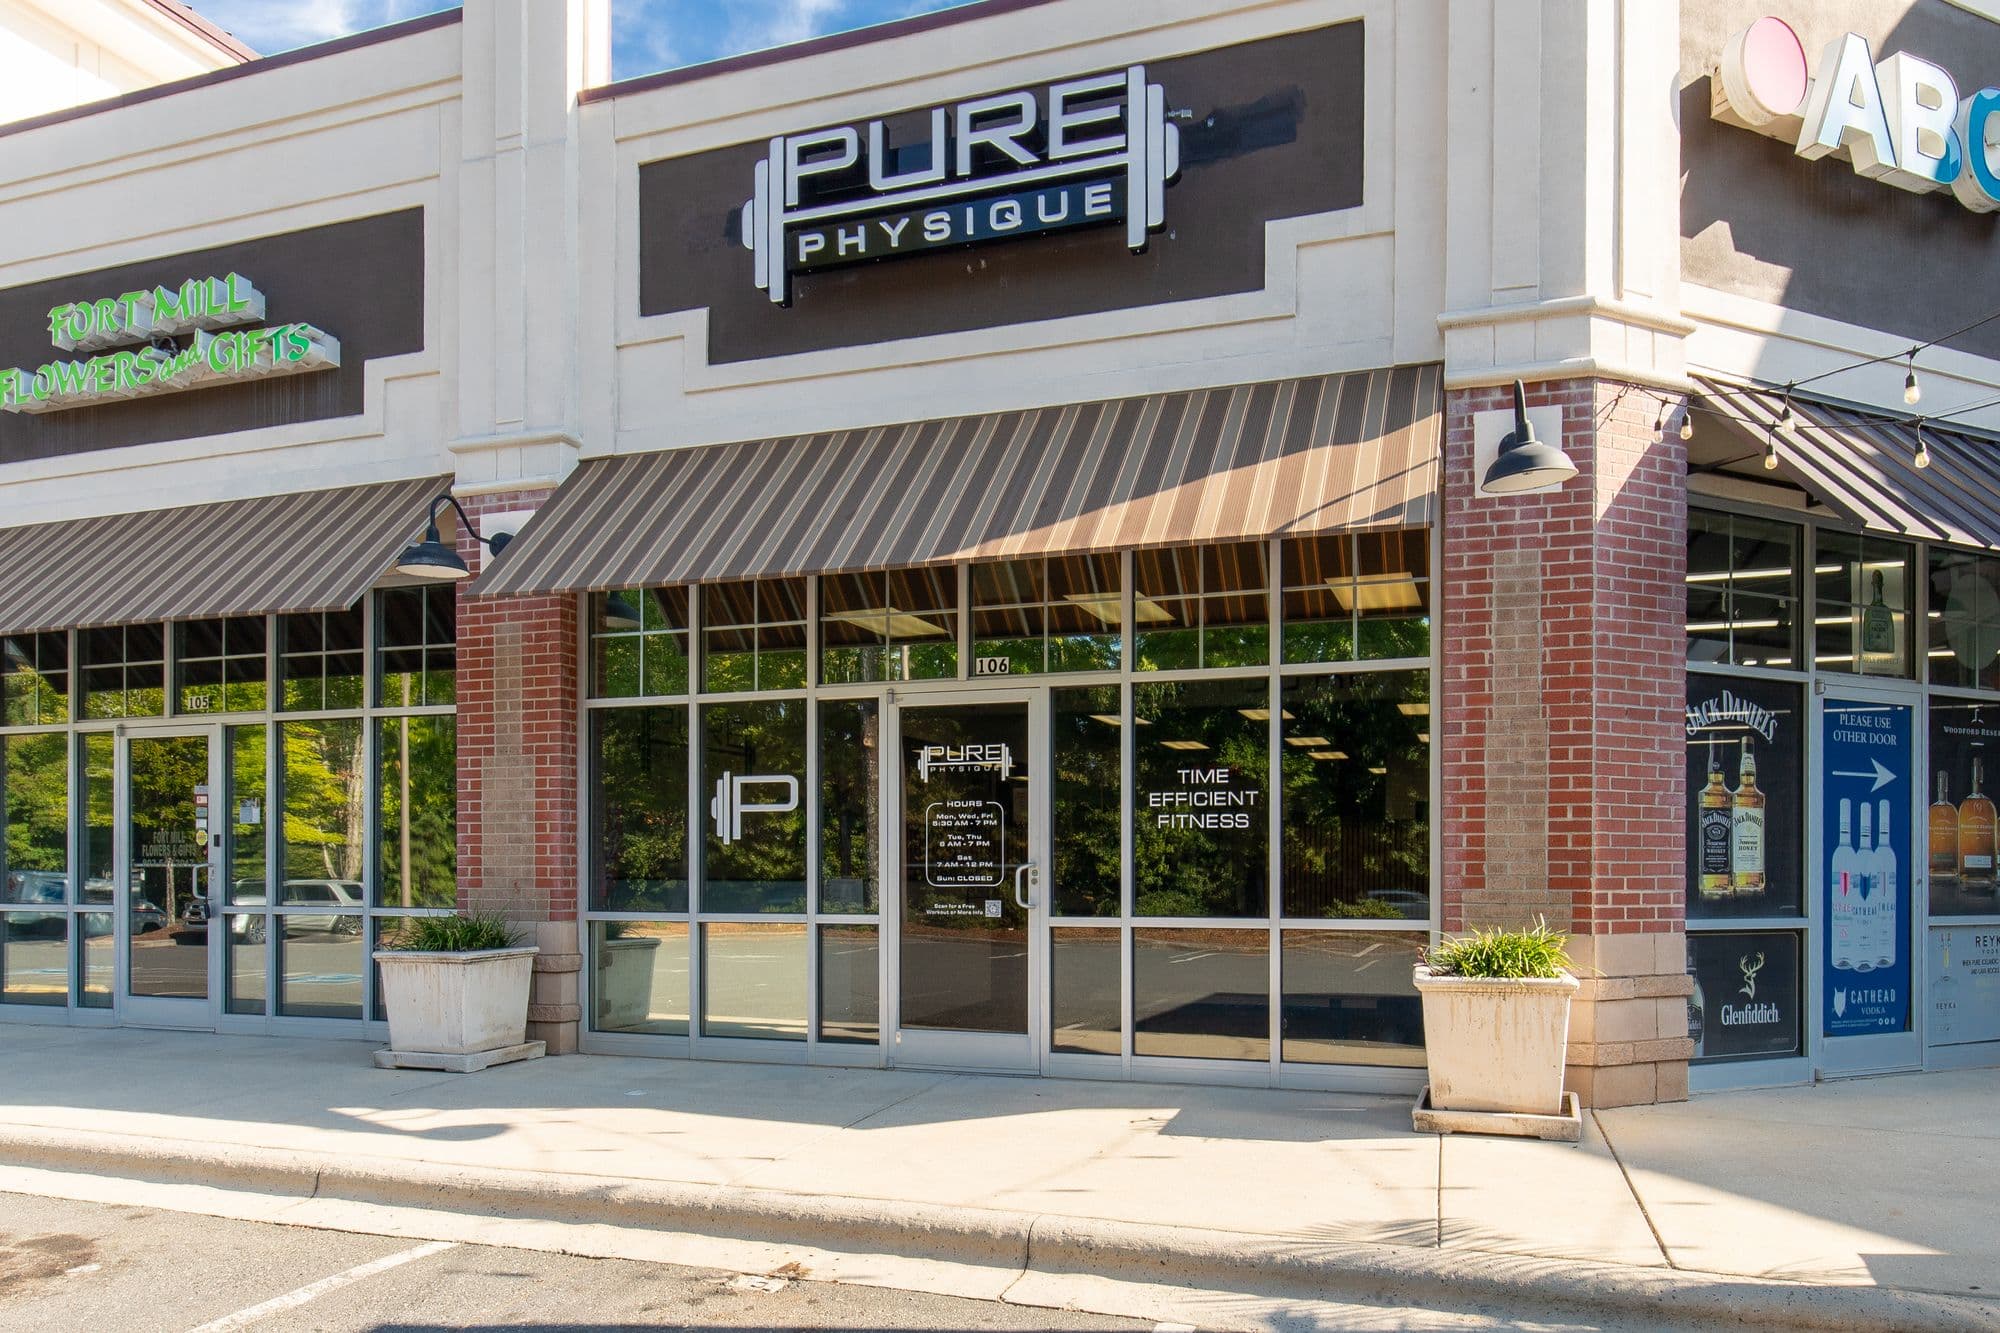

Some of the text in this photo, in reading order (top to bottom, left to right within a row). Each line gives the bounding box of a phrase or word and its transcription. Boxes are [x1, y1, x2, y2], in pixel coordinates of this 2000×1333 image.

[785, 72, 1127, 207] PURE
[799, 183, 1113, 263] PHYSIQUE
[47, 272, 252, 344] FORT MILL
[0, 323, 312, 408] FLOWERS and GIFTS
[979, 658, 1008, 673] 106
[189, 696, 208, 709] 105
[1686, 689, 1778, 741] JACK DANIEL'S
[1840, 713, 1892, 729] PLEASE USE
[1833, 729, 1897, 746] OTHER DOOR
[928, 744, 1001, 762] PURE
[930, 765, 1000, 773] PHYSIQUE
[1177, 768, 1230, 784] TIME
[946, 800, 983, 808] HOURS
[1149, 790, 1259, 807] EFFICIENT
[958, 812, 980, 820] Wed,
[1157, 813, 1250, 829] FITNESS
[1850, 988, 1896, 1004] CATHEAD
[1721, 1003, 1779, 1026] Glenfiddich
[1861, 1006, 1886, 1015] VODKA
